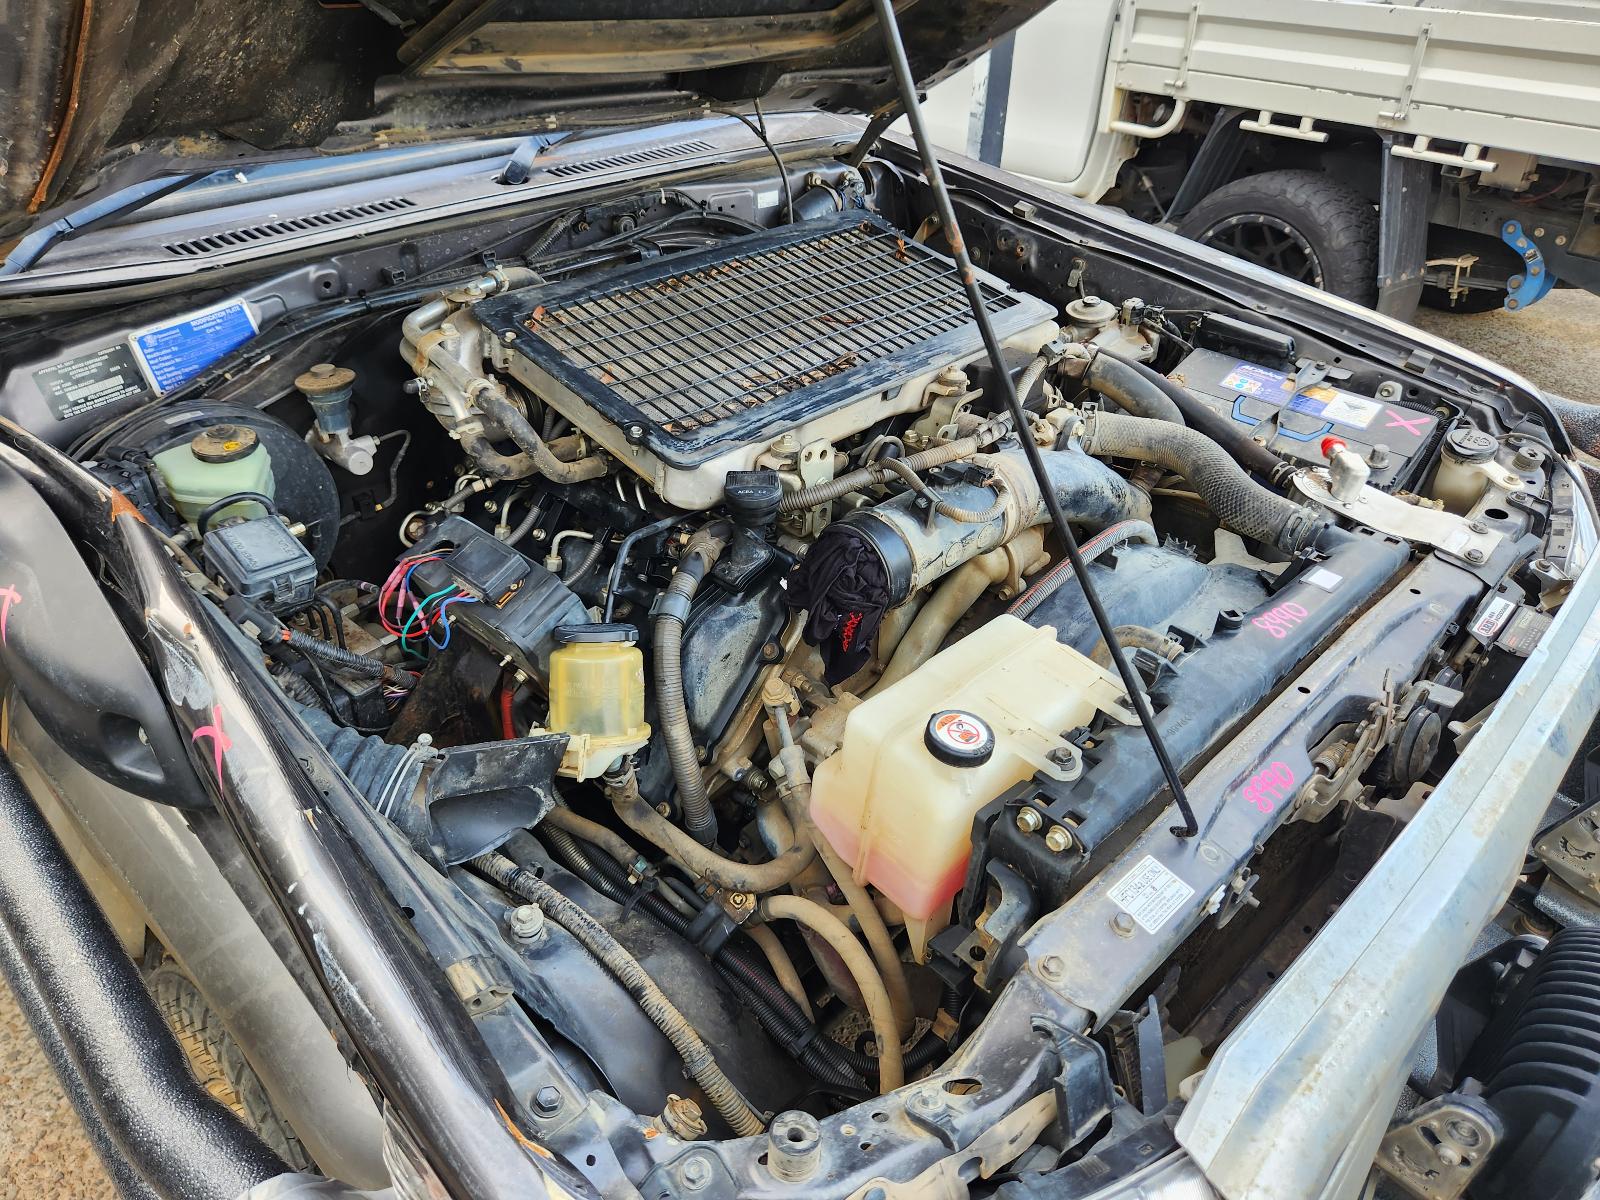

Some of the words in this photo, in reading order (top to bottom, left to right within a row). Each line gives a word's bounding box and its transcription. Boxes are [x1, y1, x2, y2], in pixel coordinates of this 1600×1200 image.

[190, 310, 225, 326] MODIFICATION
[225, 305, 240, 314] PLATE
[1251, 602, 1309, 639] 8990
[1242, 761, 1295, 813] 8990
